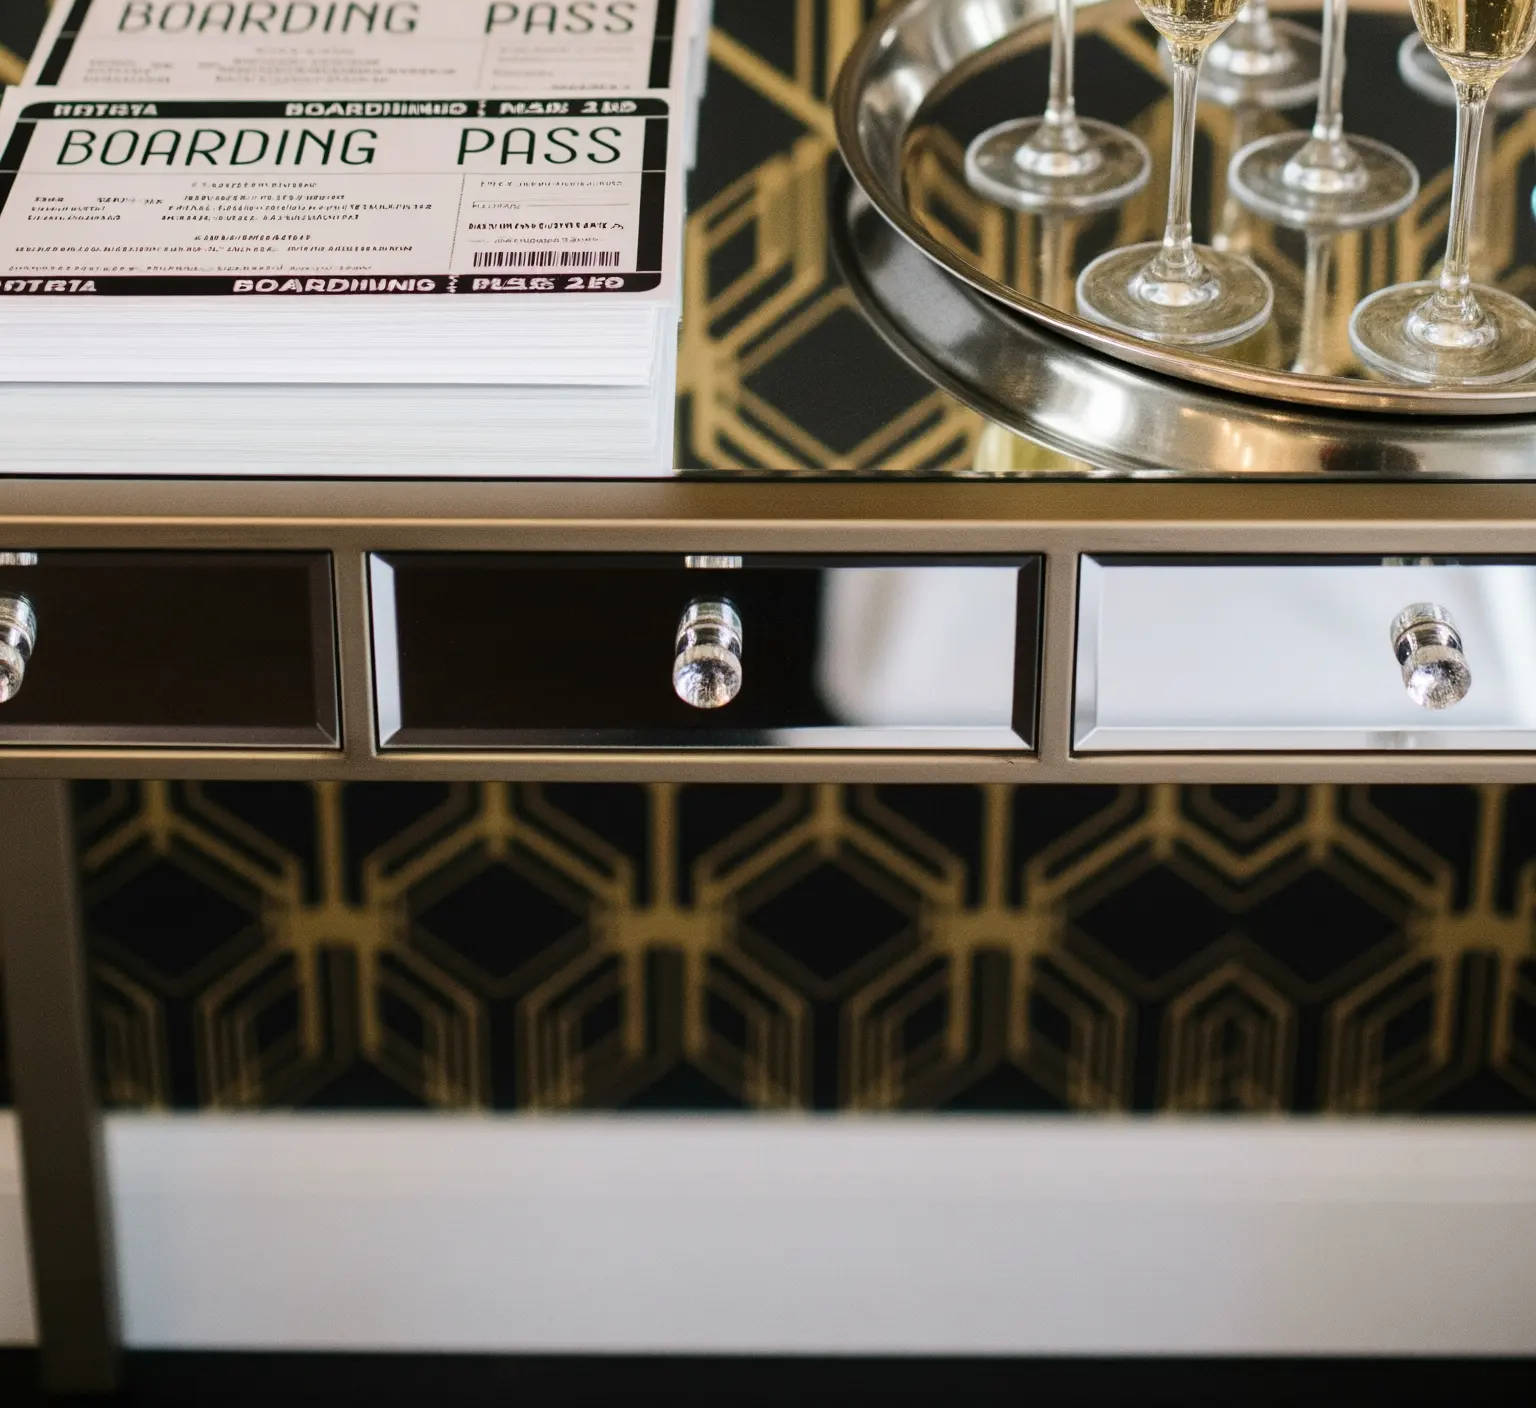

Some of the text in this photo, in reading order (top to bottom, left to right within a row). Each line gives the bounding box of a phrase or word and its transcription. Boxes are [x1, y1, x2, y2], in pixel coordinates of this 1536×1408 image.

[117, 0, 637, 35] BOARDING PASS
[56, 127, 622, 167] BOARDING PASS
